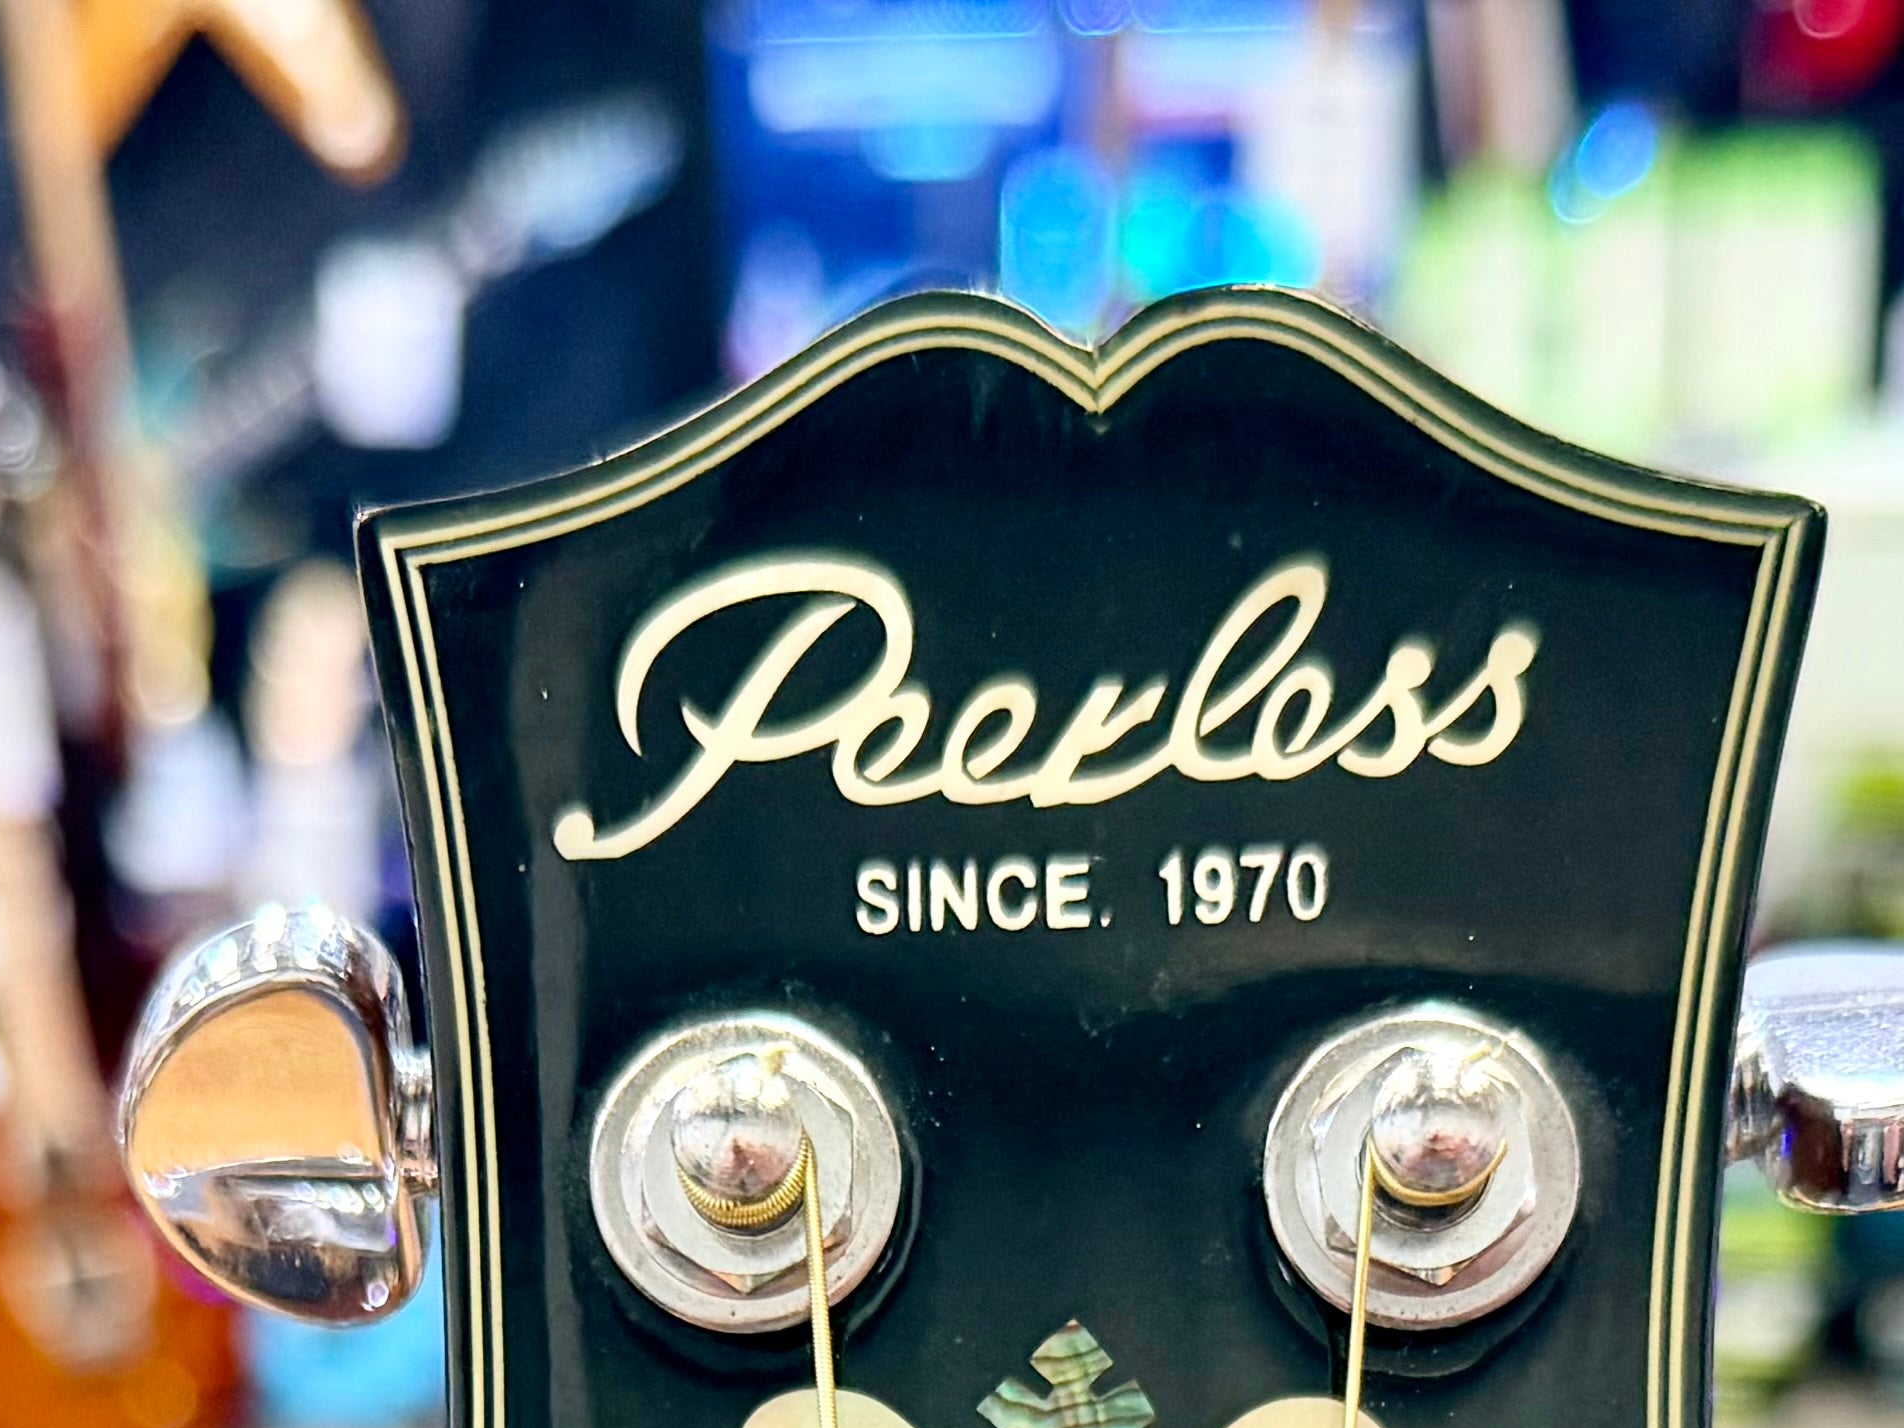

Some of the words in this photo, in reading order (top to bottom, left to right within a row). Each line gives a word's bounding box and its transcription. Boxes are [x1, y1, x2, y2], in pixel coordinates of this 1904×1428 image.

[552, 552, 1538, 862] Peerless
[854, 856, 1112, 936] SINCE.
[1156, 845, 1329, 926] 1970
